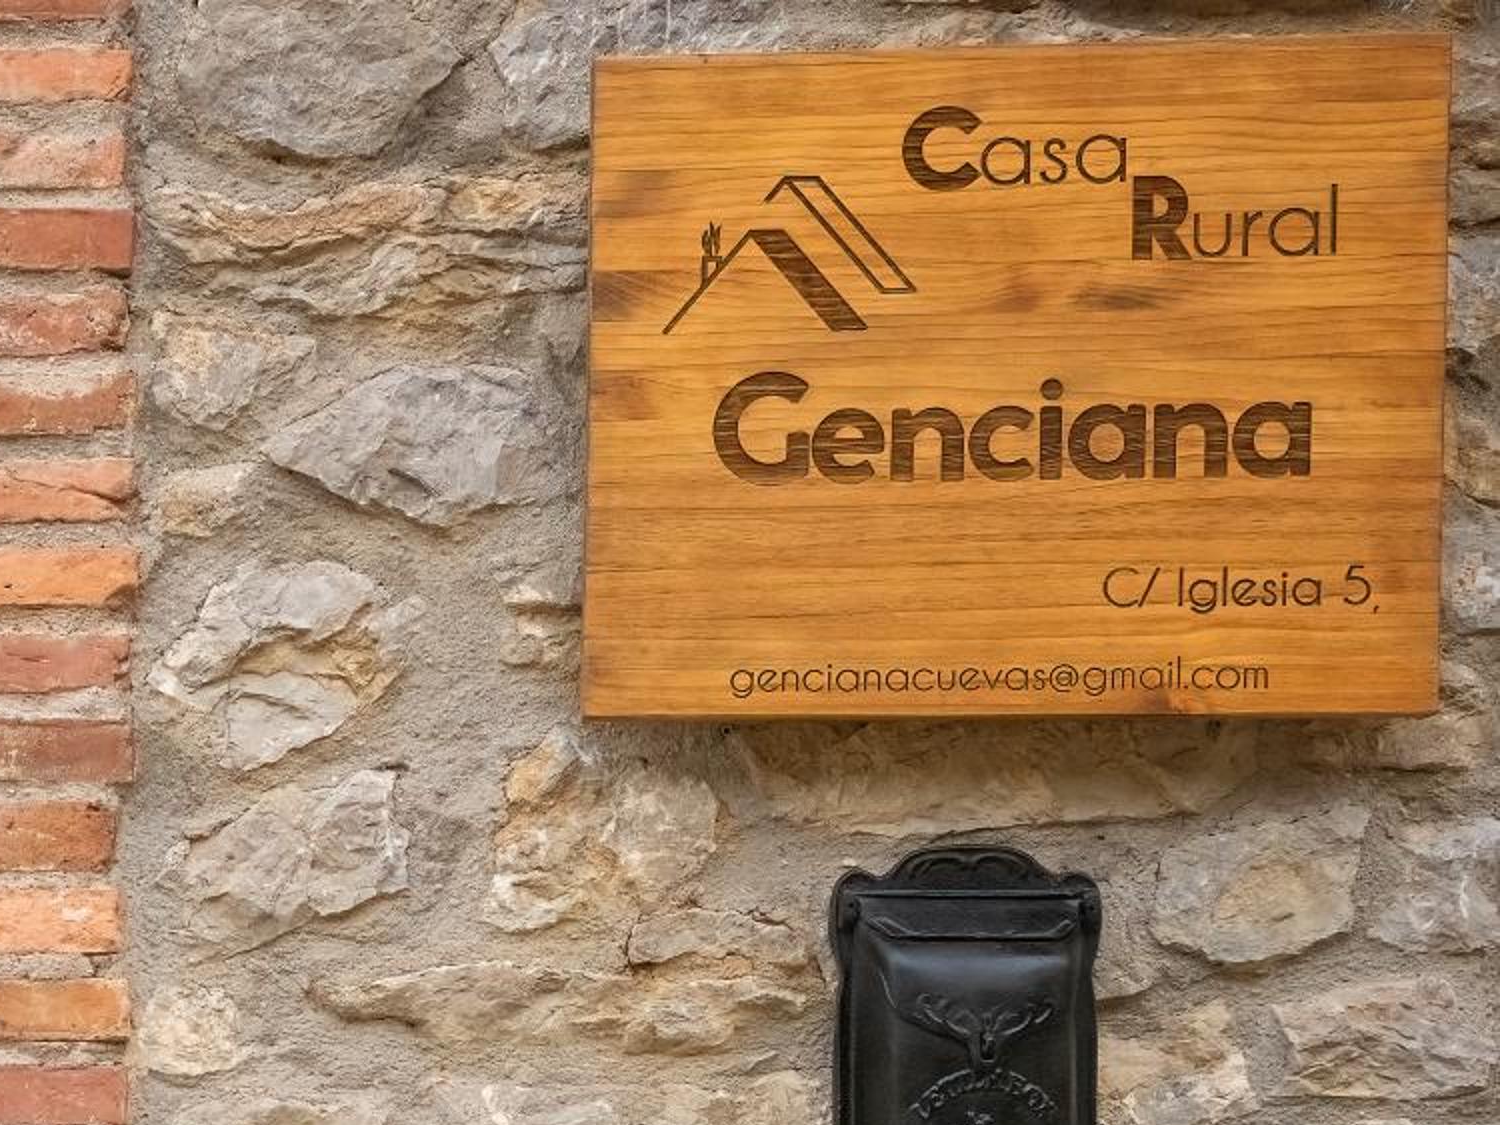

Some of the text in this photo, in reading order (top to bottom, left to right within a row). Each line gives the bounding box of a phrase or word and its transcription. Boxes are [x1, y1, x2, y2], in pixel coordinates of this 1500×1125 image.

[901, 105, 1128, 192] Casa
[1131, 175, 1339, 261] Rural
[712, 371, 1313, 486] Genciana
[1102, 566, 1161, 609] C/
[1176, 565, 1322, 615] Iglesia
[729, 655, 1269, 698] gencianacuevas@gmail.com
